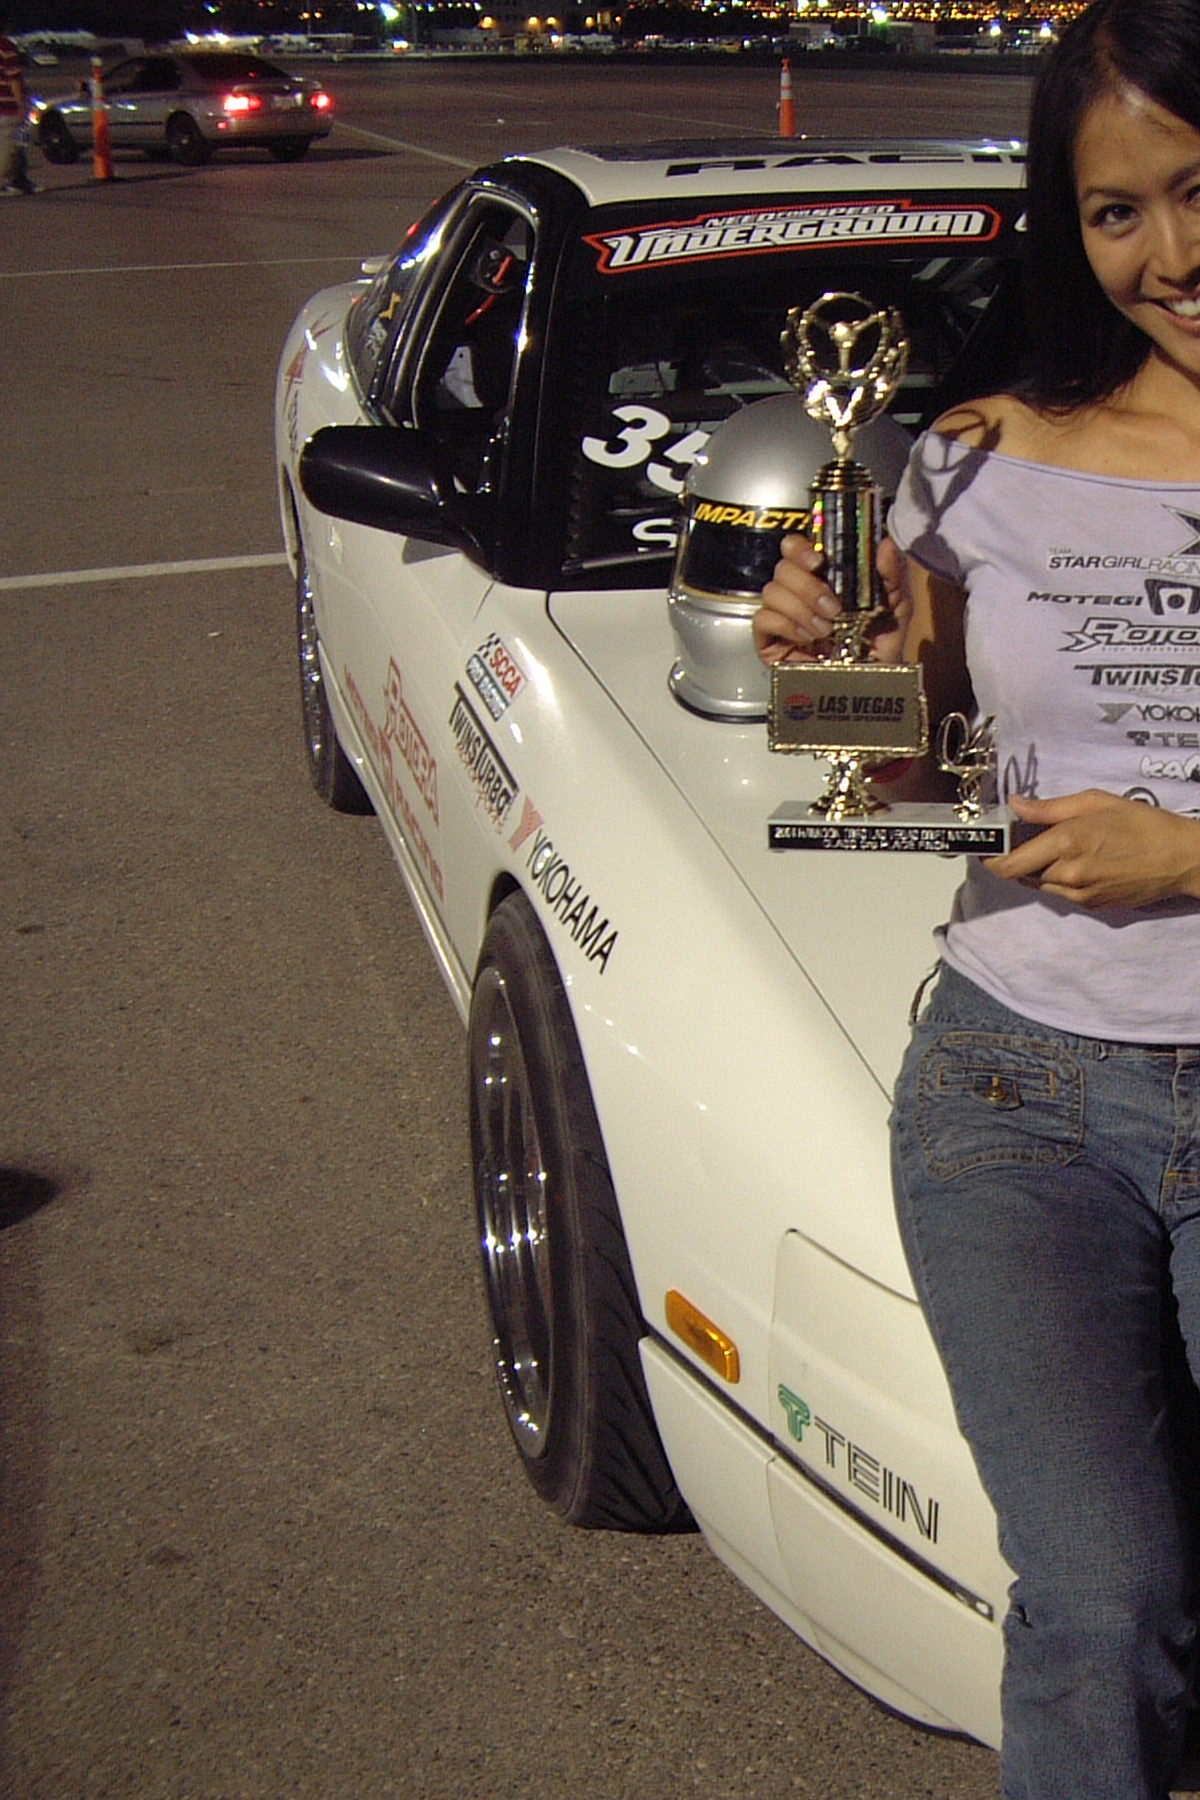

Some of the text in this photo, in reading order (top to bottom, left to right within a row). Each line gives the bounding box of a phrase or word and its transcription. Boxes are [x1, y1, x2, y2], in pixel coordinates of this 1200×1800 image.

[602, 210, 985, 267] UNDERGROUND
[1026, 590, 1144, 607] MOTEGI
[489, 647, 522, 699] SCCA
[816, 695, 905, 715] LAS VEGAS
[526, 828, 618, 976] YOKOHAMA
[814, 1415, 939, 1544] TEIN
